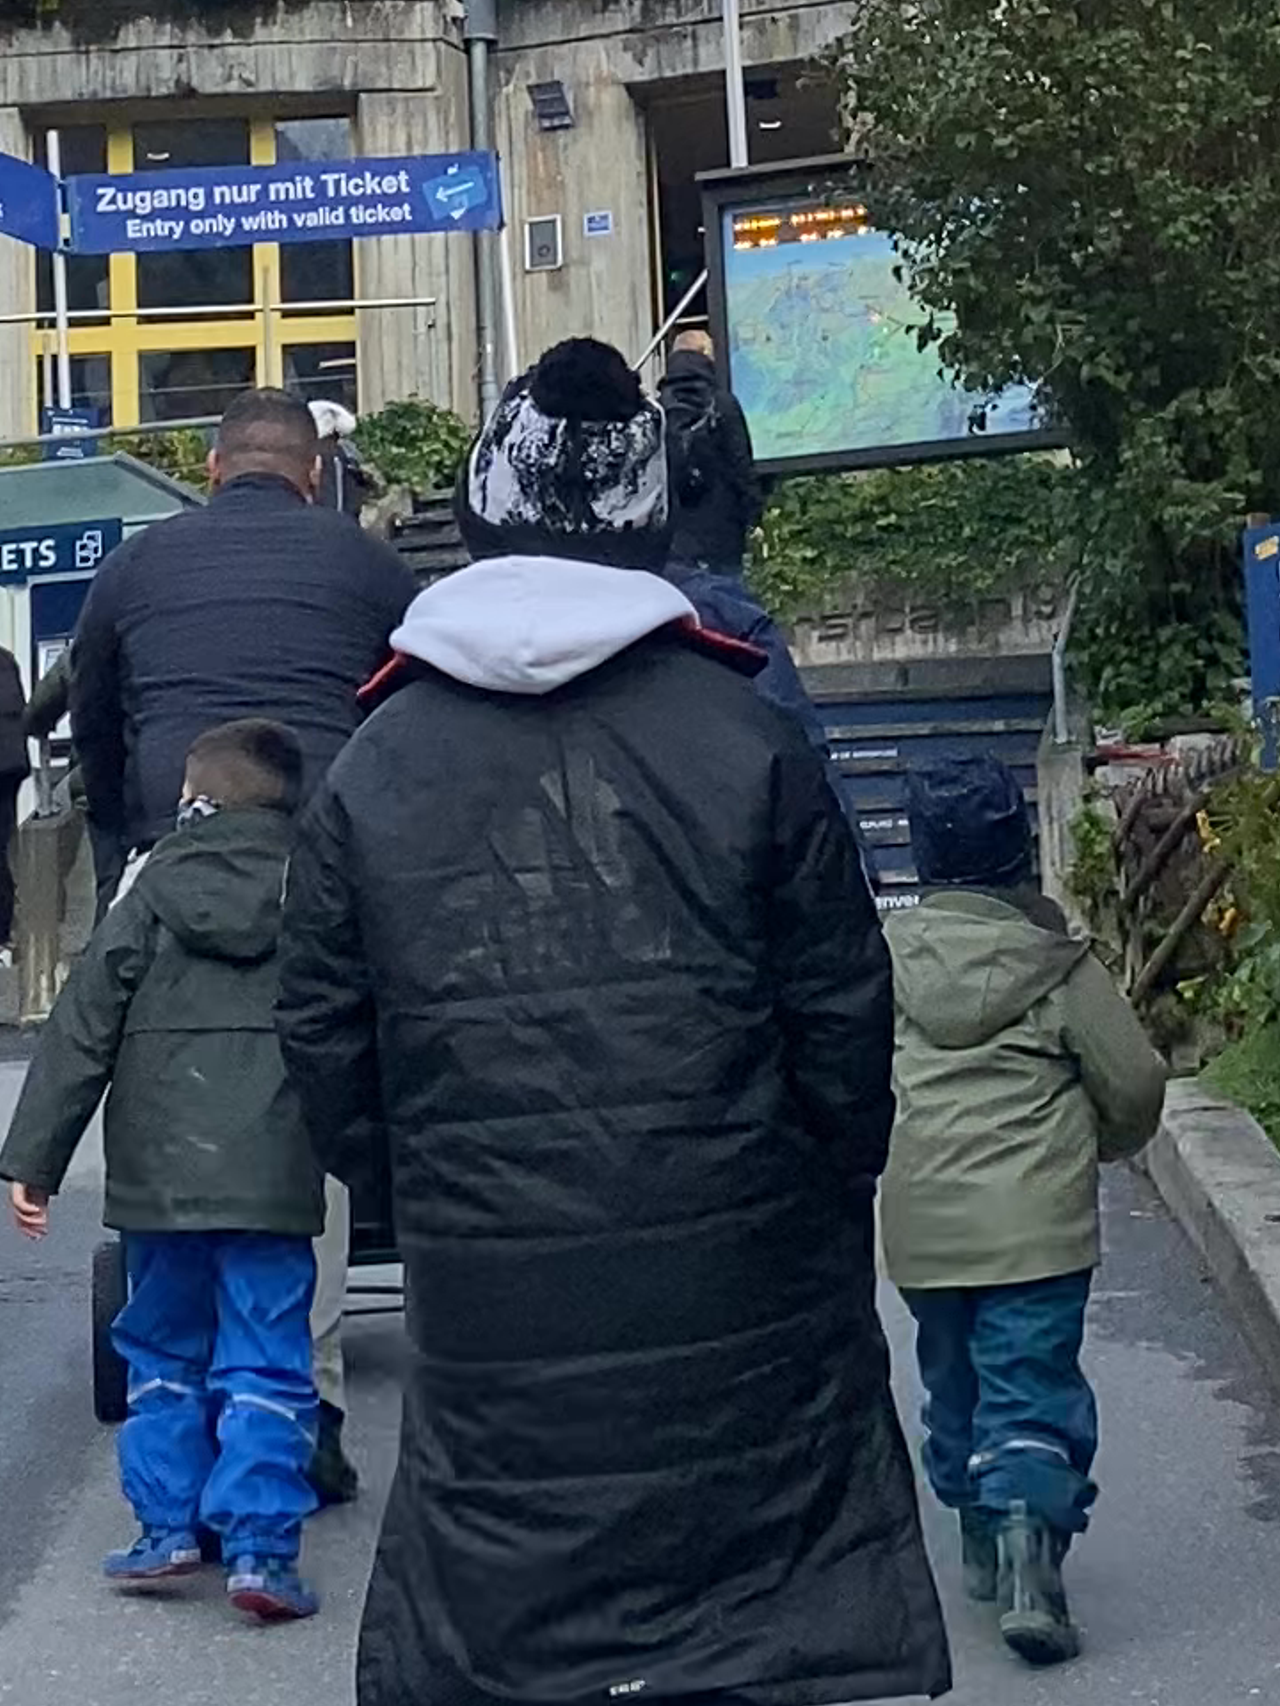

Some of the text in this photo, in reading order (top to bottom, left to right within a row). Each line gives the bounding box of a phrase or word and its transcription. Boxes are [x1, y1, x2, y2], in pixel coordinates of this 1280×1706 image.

[96, 169, 410, 216] Zugang nur mit Ticket
[126, 202, 412, 243] Entry only with valid ticket
